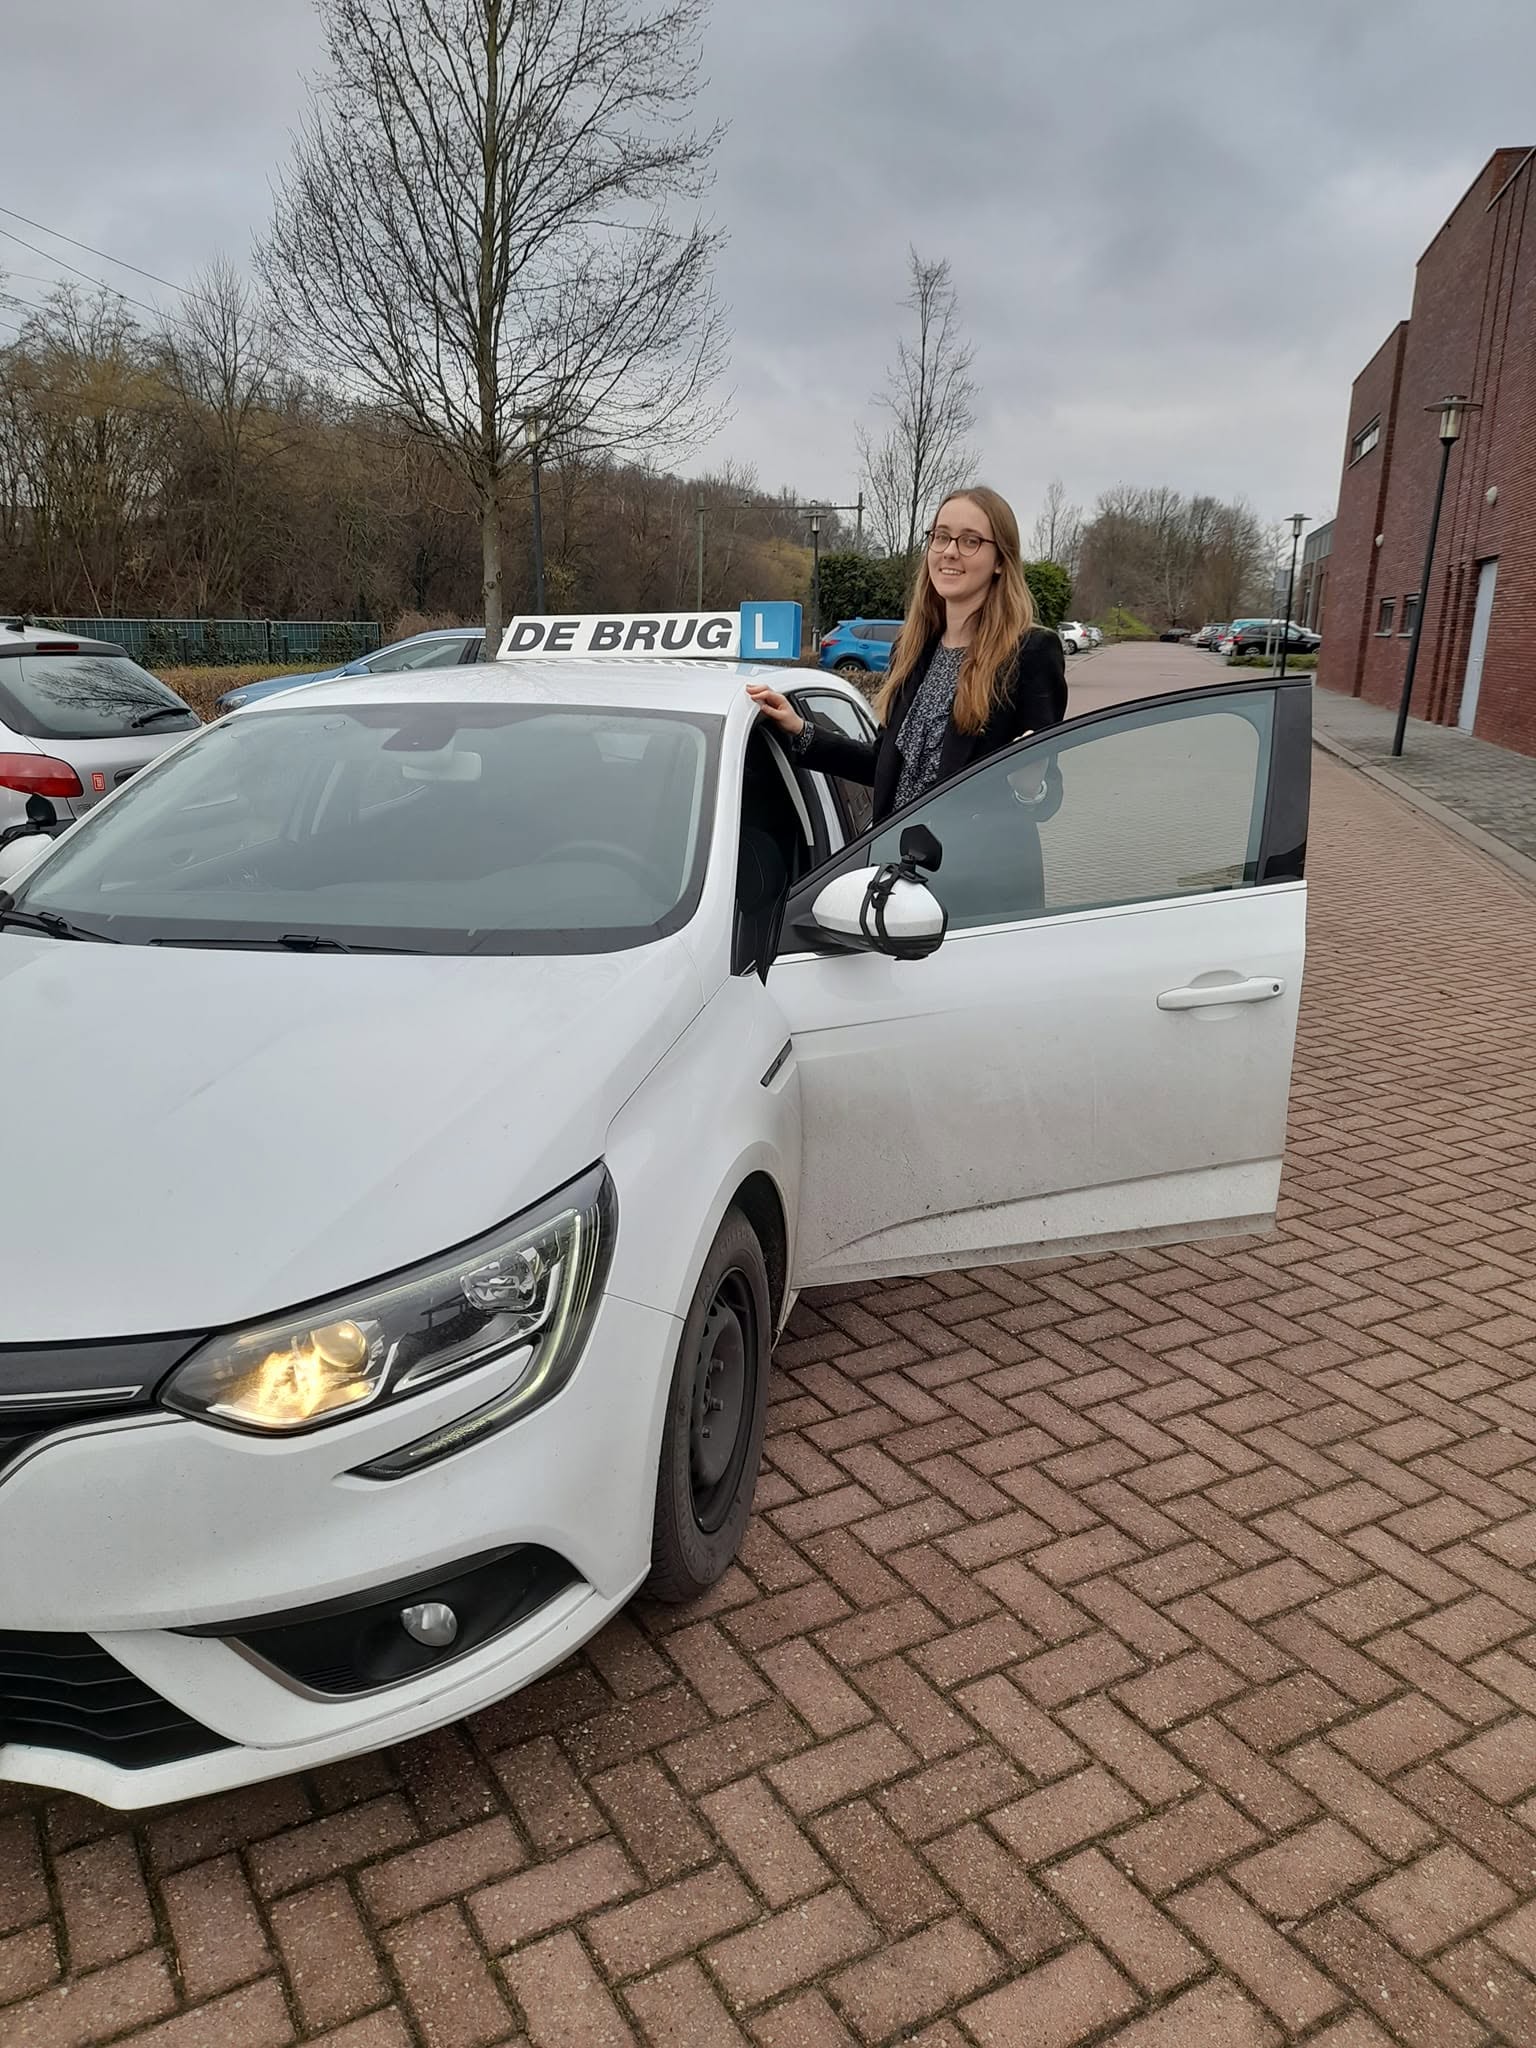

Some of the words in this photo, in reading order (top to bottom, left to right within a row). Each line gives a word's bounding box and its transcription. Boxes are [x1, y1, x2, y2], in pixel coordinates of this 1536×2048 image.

[507, 621, 581, 652] DE
[588, 617, 733, 651] BRUG
[754, 612, 779, 650] L
